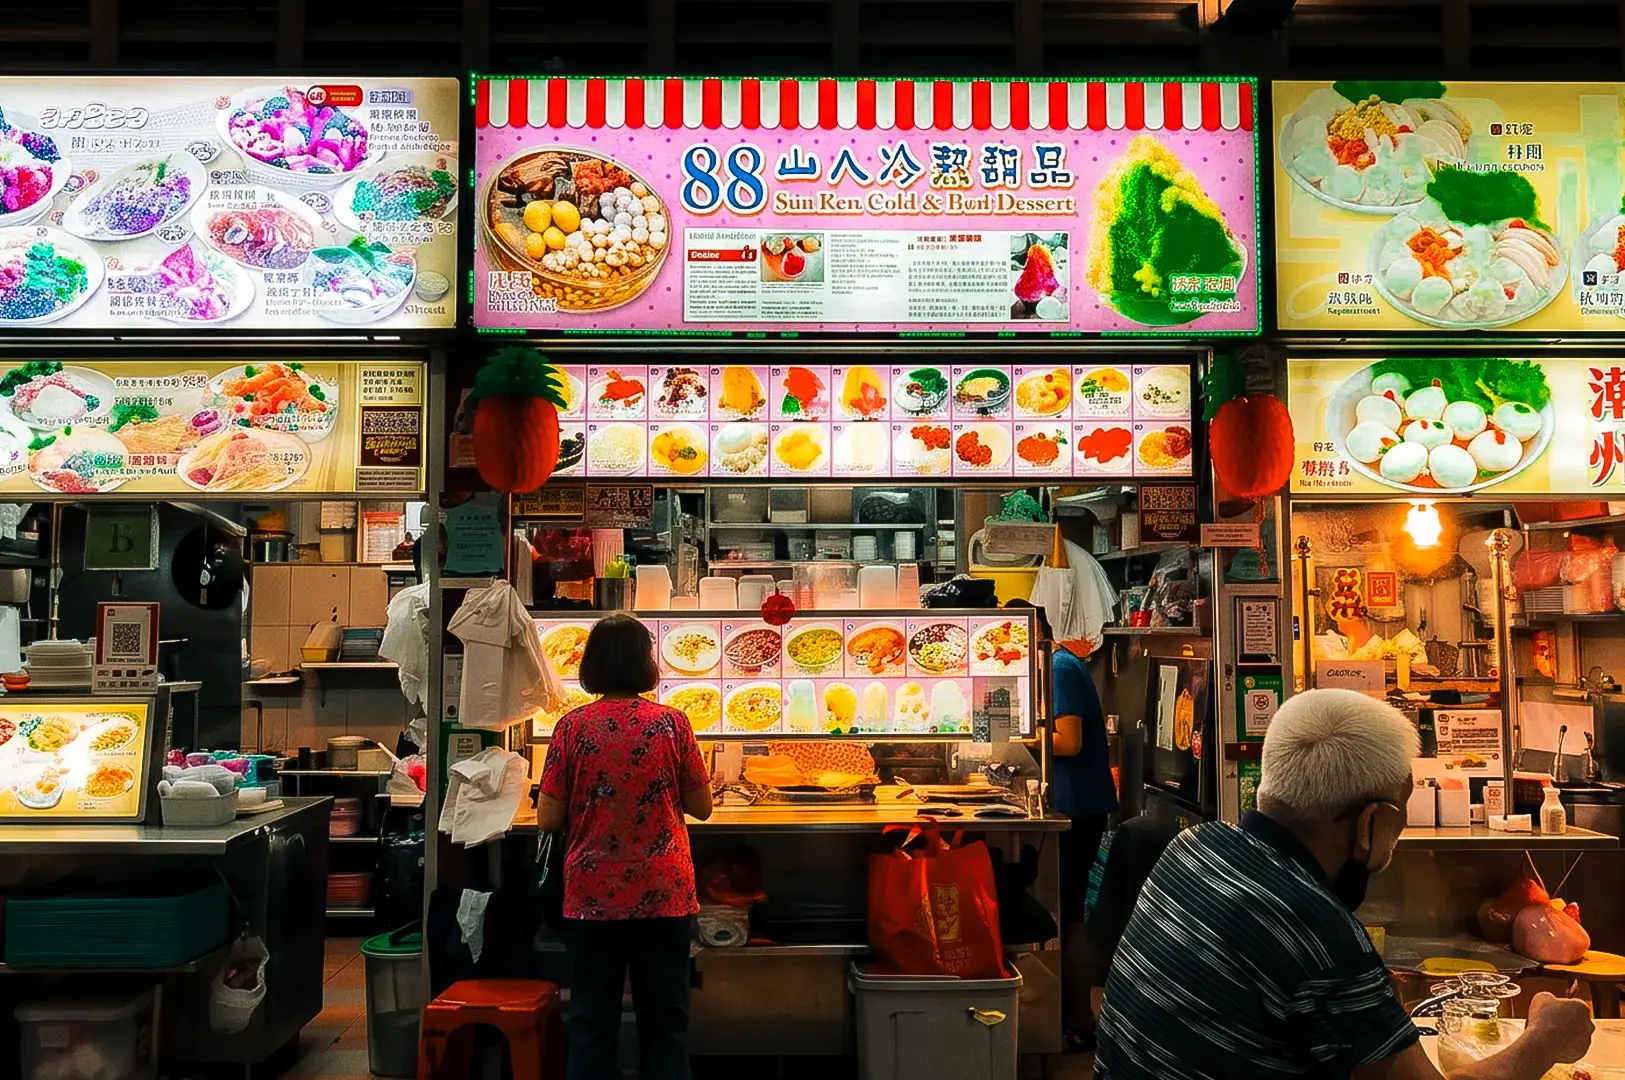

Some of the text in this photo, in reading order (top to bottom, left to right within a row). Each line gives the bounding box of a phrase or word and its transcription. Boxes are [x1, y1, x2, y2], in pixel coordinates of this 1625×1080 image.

[683, 146, 764, 210] 88
[868, 193, 916, 210] Cold
[922, 194, 942, 210] &
[997, 193, 1073, 211] Dessert
